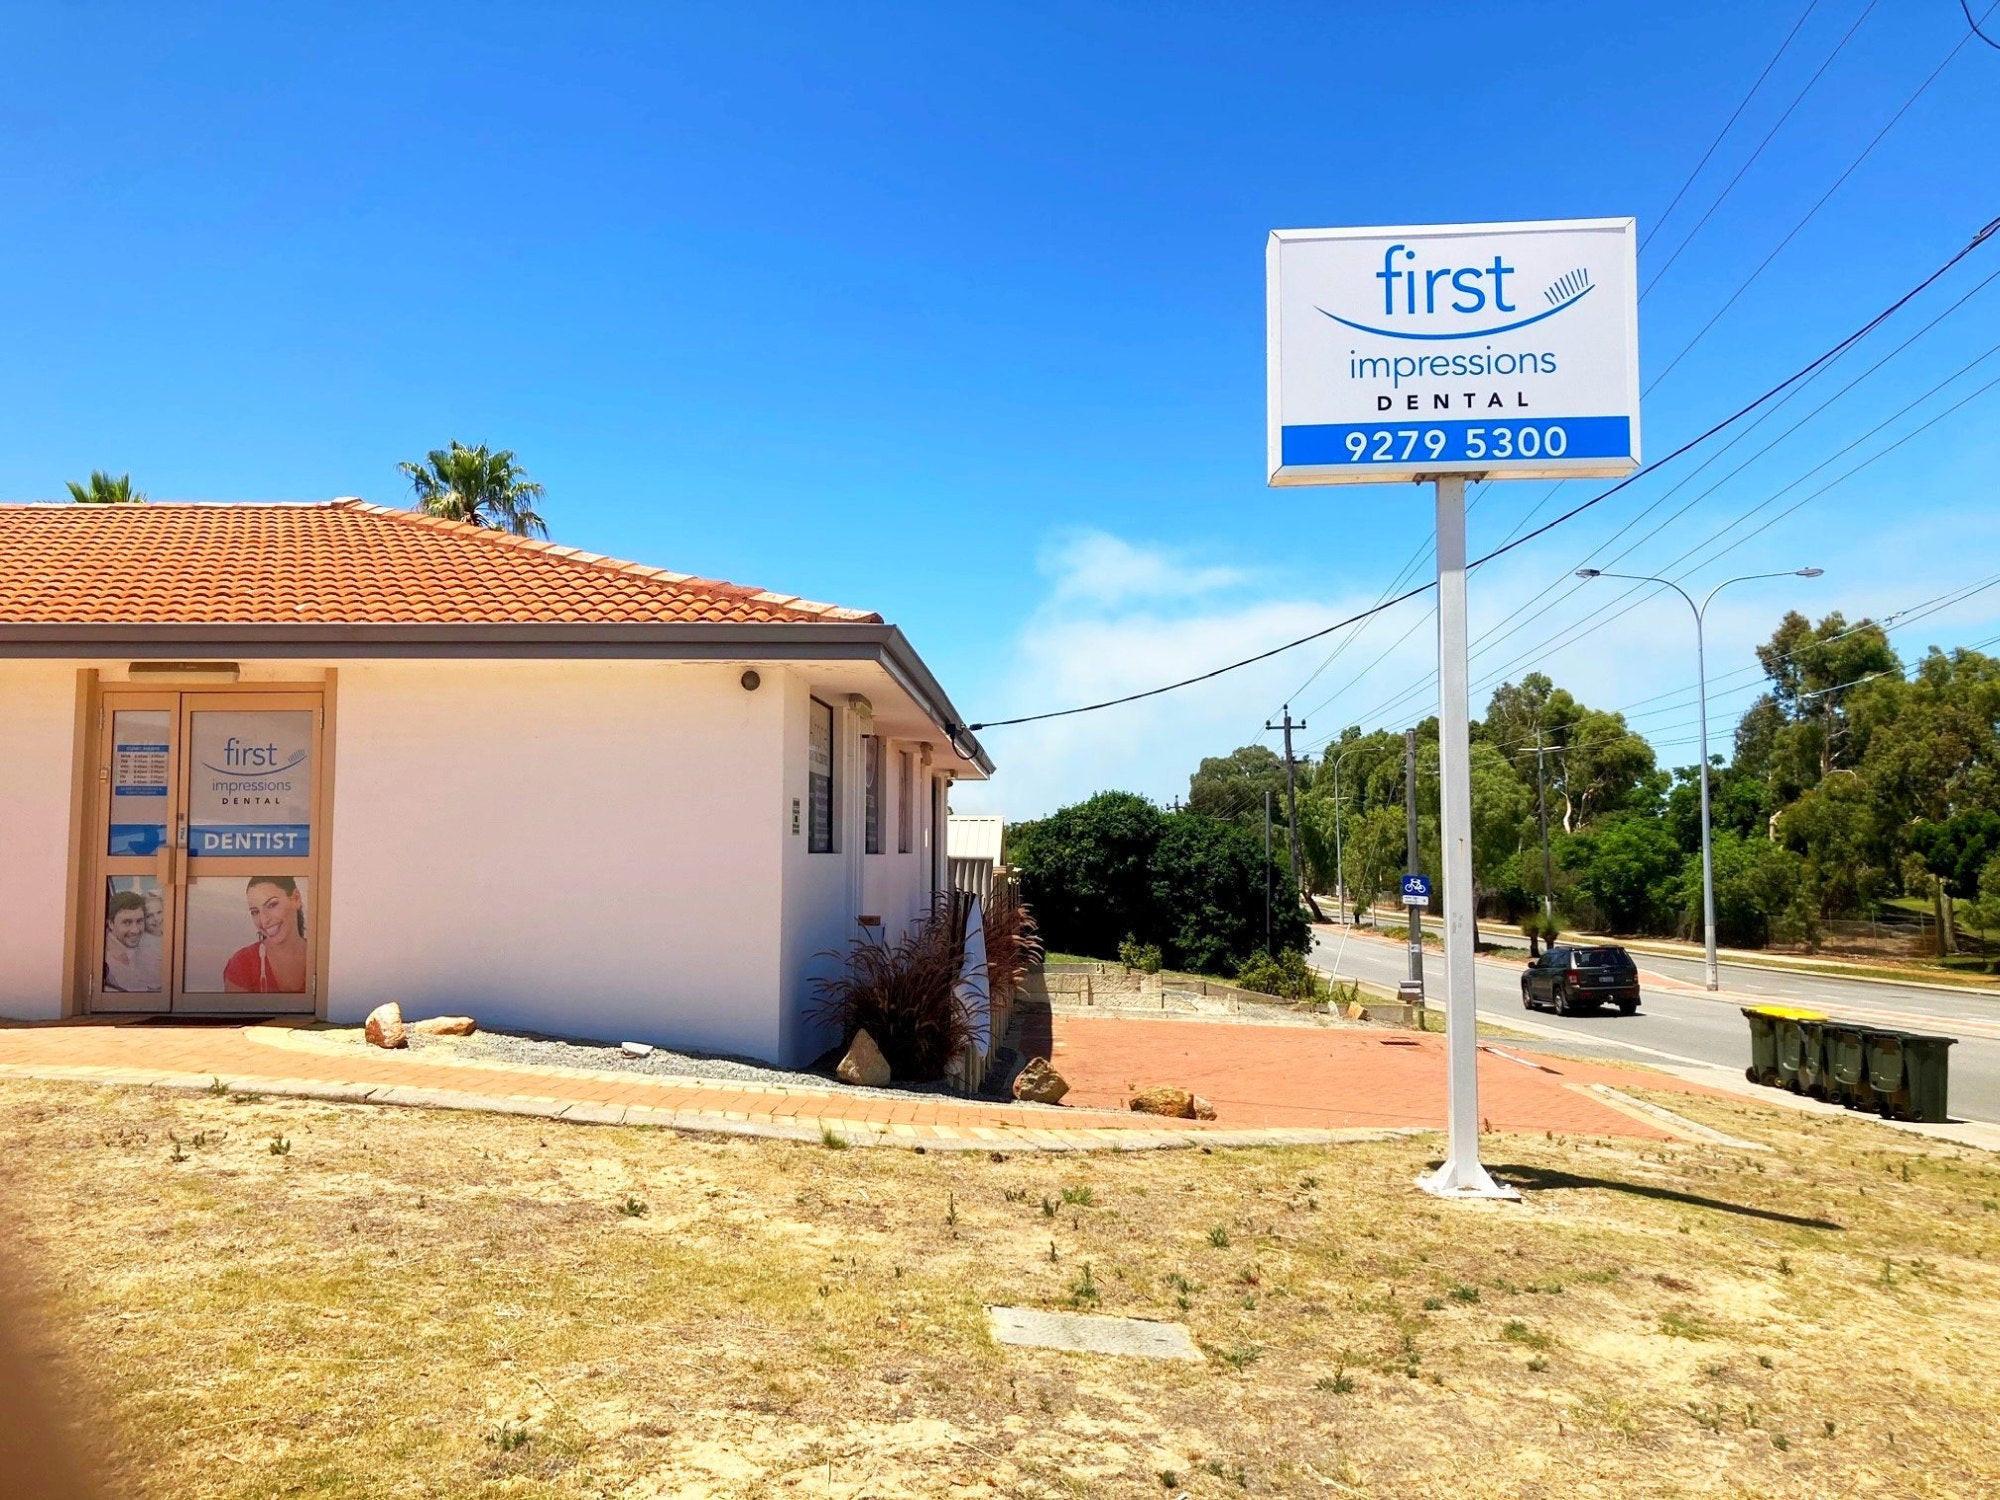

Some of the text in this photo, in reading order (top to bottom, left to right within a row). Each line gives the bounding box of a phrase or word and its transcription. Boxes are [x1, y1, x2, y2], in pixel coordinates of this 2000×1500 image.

[1376, 244, 1515, 314] first
[1351, 345, 1557, 388] impressions
[1377, 392, 1529, 411] DENTAL
[1345, 426, 1567, 462] 9279 5300
[224, 738, 278, 766] first
[212, 778, 292, 795] impressions
[222, 797, 281, 805] DENTAL
[205, 832, 298, 849] DENTIST
